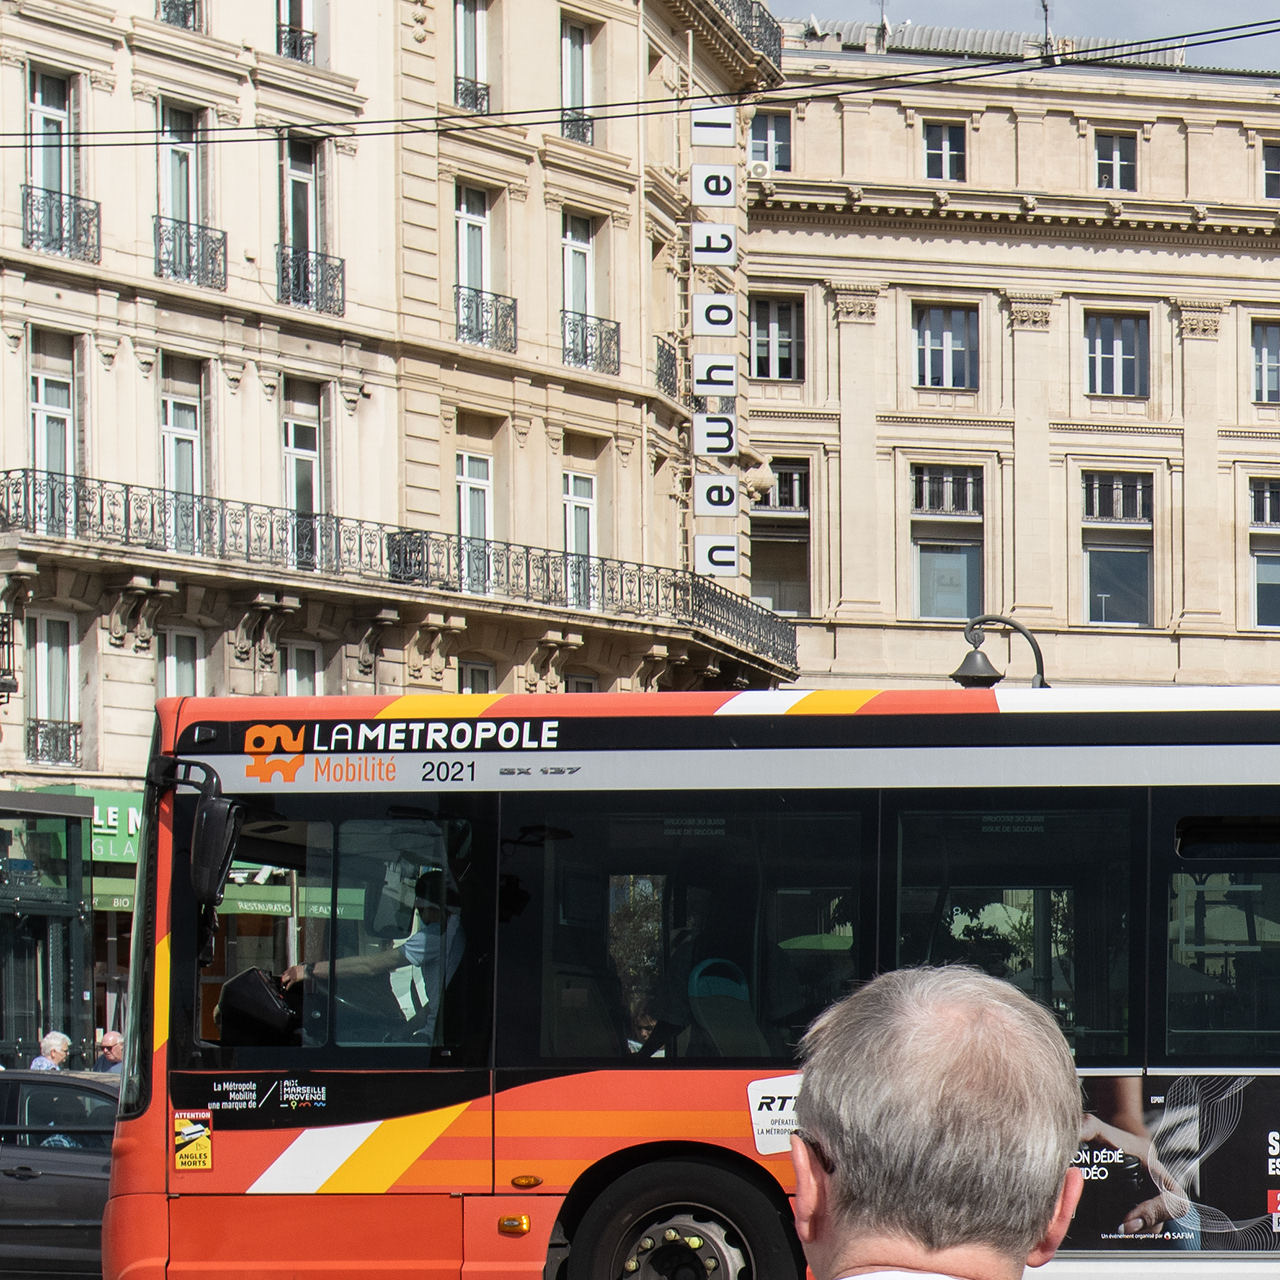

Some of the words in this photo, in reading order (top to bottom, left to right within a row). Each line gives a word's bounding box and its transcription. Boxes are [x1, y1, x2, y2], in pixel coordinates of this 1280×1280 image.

[314, 756, 396, 783] Mobilité
[422, 761, 476, 782] 2021
[93, 805, 119, 827] LE
[92, 839, 135, 857] GLA
[113, 898, 130, 908] BIO
[238, 901, 292, 913] RESTAURATIO
[213, 1082, 222, 1091] La
[223, 1081, 256, 1093] Métropole
[229, 1091, 256, 1101] Mobilité
[283, 1093, 326, 1101] PROVENCE
[208, 1101, 220, 1109] une
[222, 1101, 246, 1111] marque
[247, 1100, 257, 1108] de
[771, 1118, 799, 1126] OPÉRATEU
[765, 1127, 792, 1135] MÉTROPO
[1070, 1149, 1090, 1164] ON
[1093, 1147, 1124, 1163] DÉDIÉ
[1172, 1232, 1194, 1240] SAFIM
